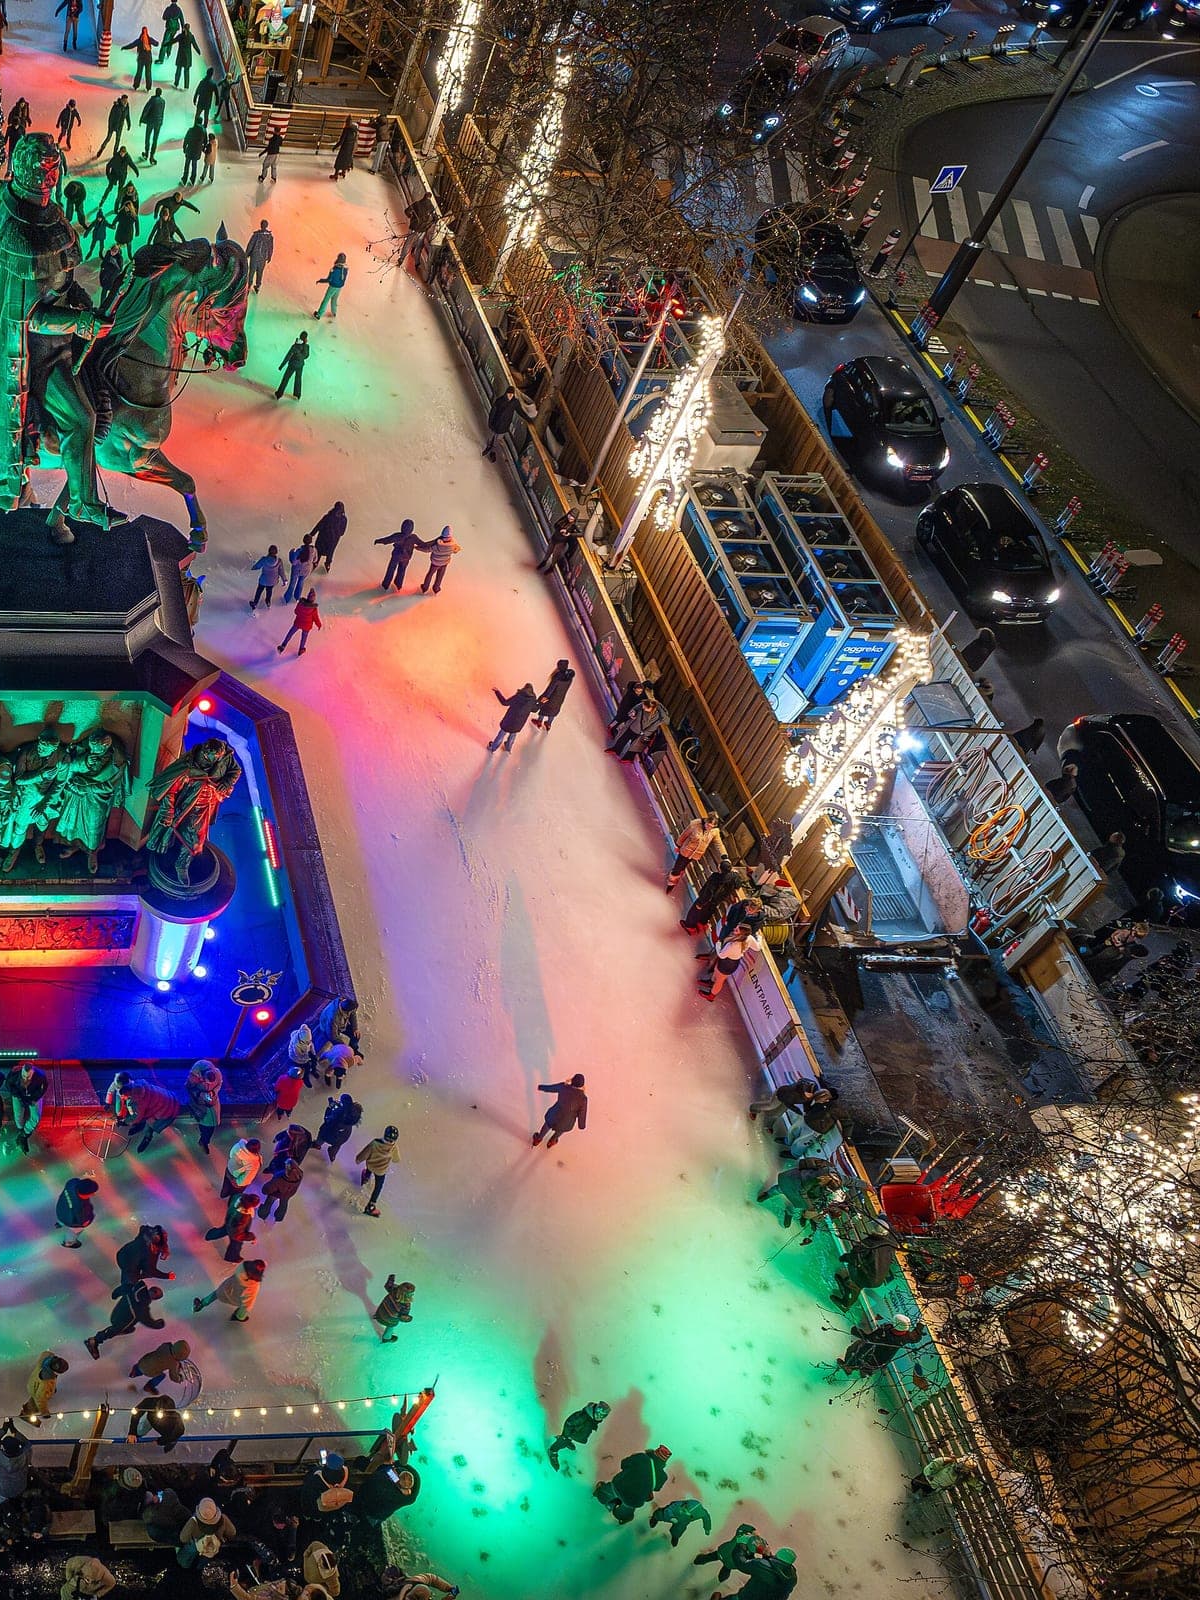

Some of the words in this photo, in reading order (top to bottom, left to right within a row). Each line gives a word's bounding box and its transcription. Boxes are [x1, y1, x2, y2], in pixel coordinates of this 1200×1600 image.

[749, 640, 790, 649] aggreko
[843, 645, 884, 654] aggreko
[748, 968, 774, 1019] LENTPARK
